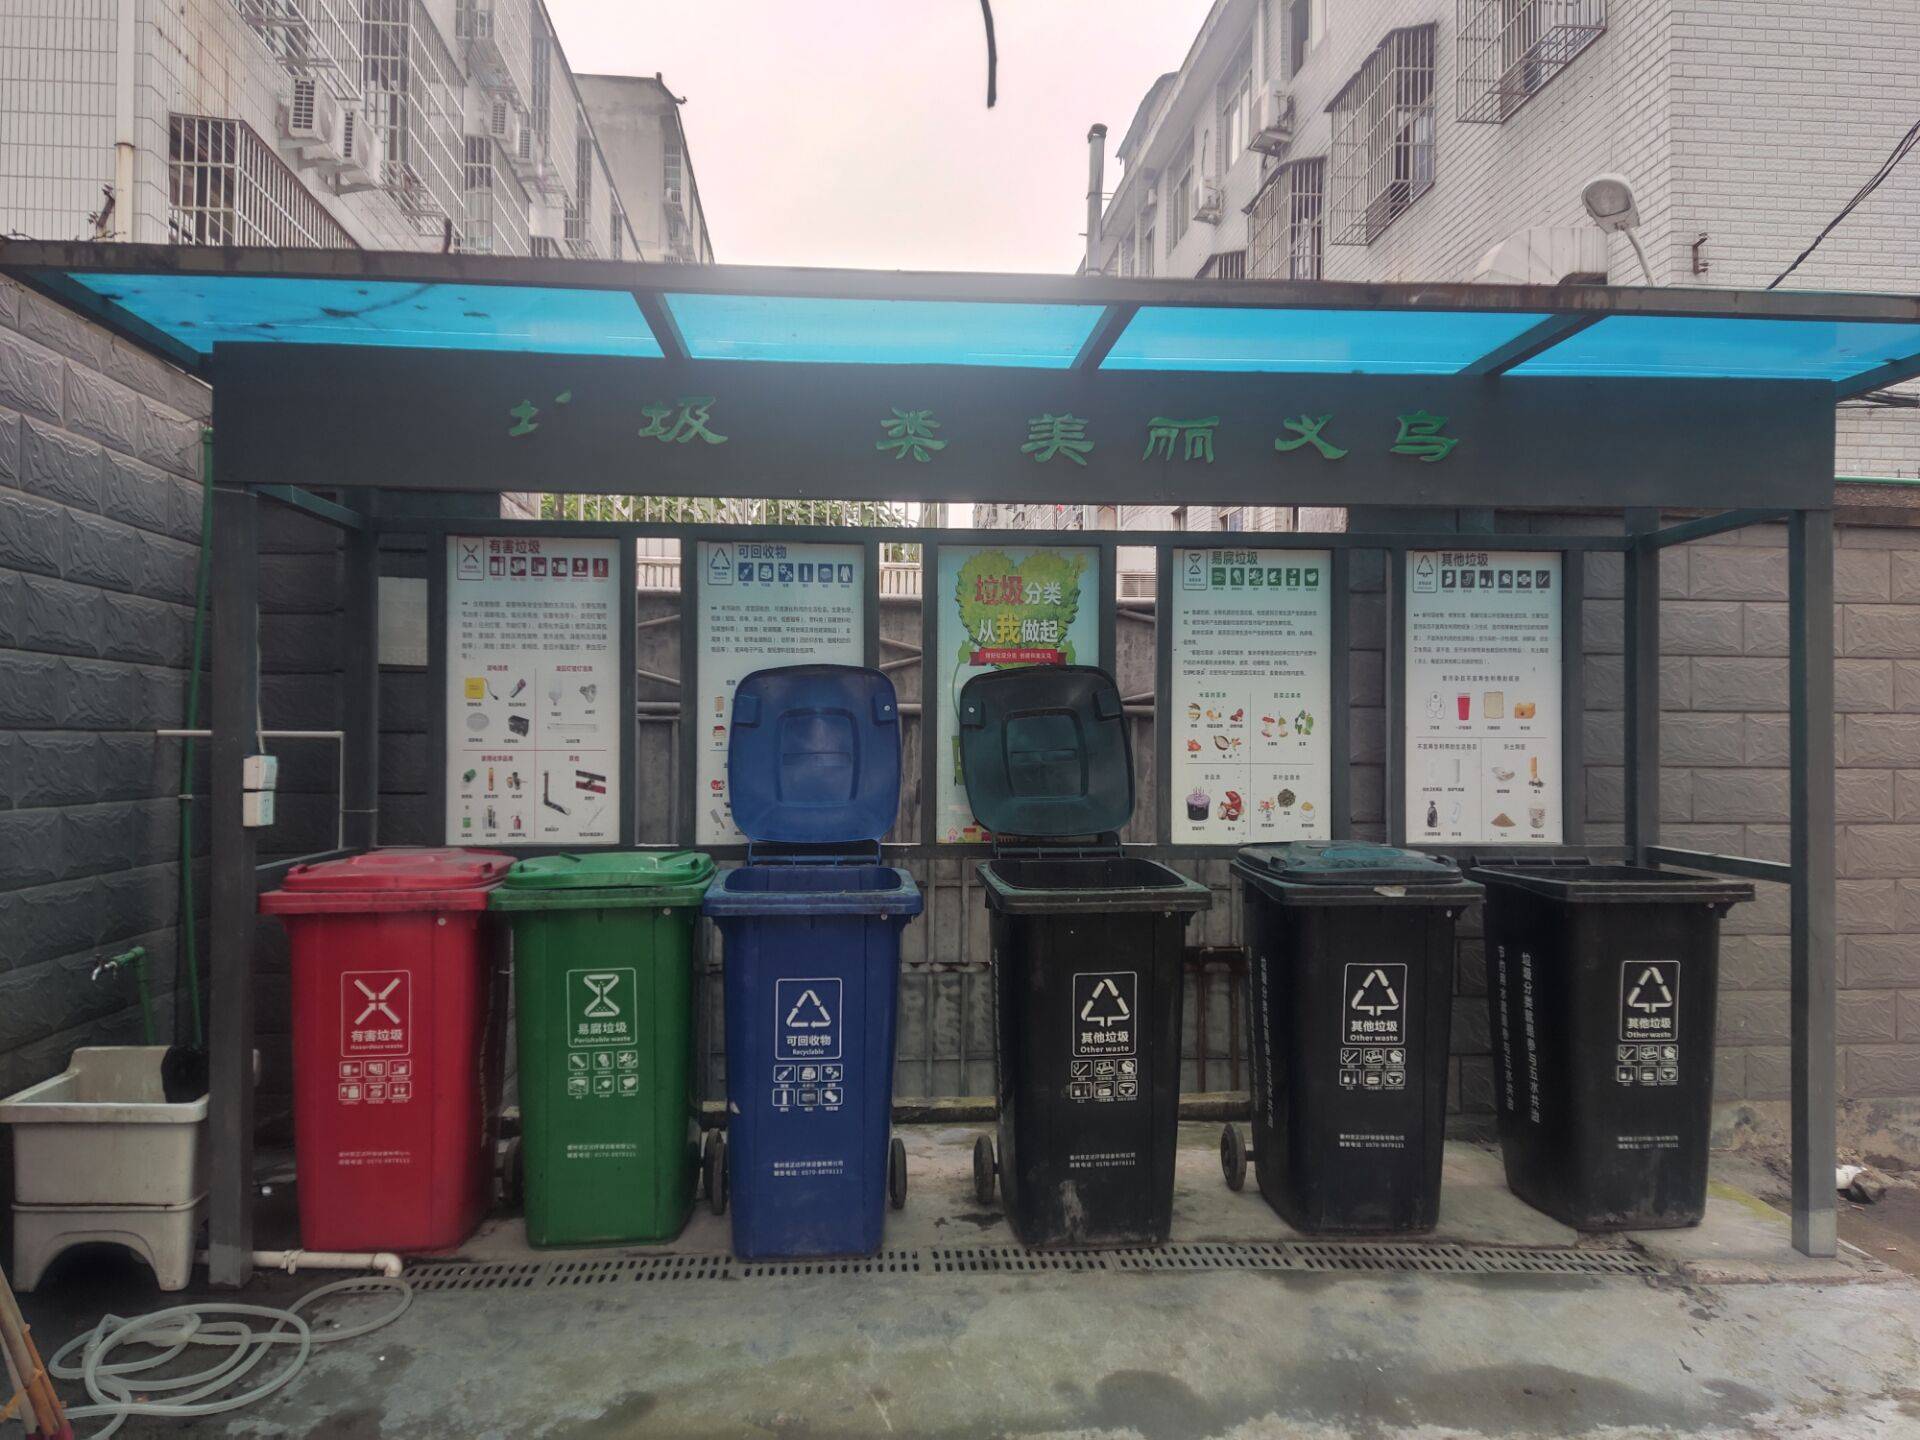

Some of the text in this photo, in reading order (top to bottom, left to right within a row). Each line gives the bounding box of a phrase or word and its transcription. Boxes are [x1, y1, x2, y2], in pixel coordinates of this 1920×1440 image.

[489, 539, 541, 554] 有害垃圾
[738, 544, 787, 559] 可回收物
[1211, 551, 1258, 565] 易腐垃圾
[1441, 553, 1488, 567] 其他垃圾
[975, 574, 1063, 606] 垃圾分类
[977, 613, 1059, 644] 从我做起
[577, 1022, 627, 1035] 易腐垃圾
[1351, 1020, 1398, 1032] 其他垃圾
[1627, 1017, 1672, 1029] 其他垃圾
[351, 1029, 403, 1042] 有害垃圾
[786, 1035, 832, 1046] 可回收物
[1081, 1031, 1129, 1044] 其他垃圾
[1350, 1034, 1373, 1042] Other
[1080, 1045, 1129, 1053] Other waste
